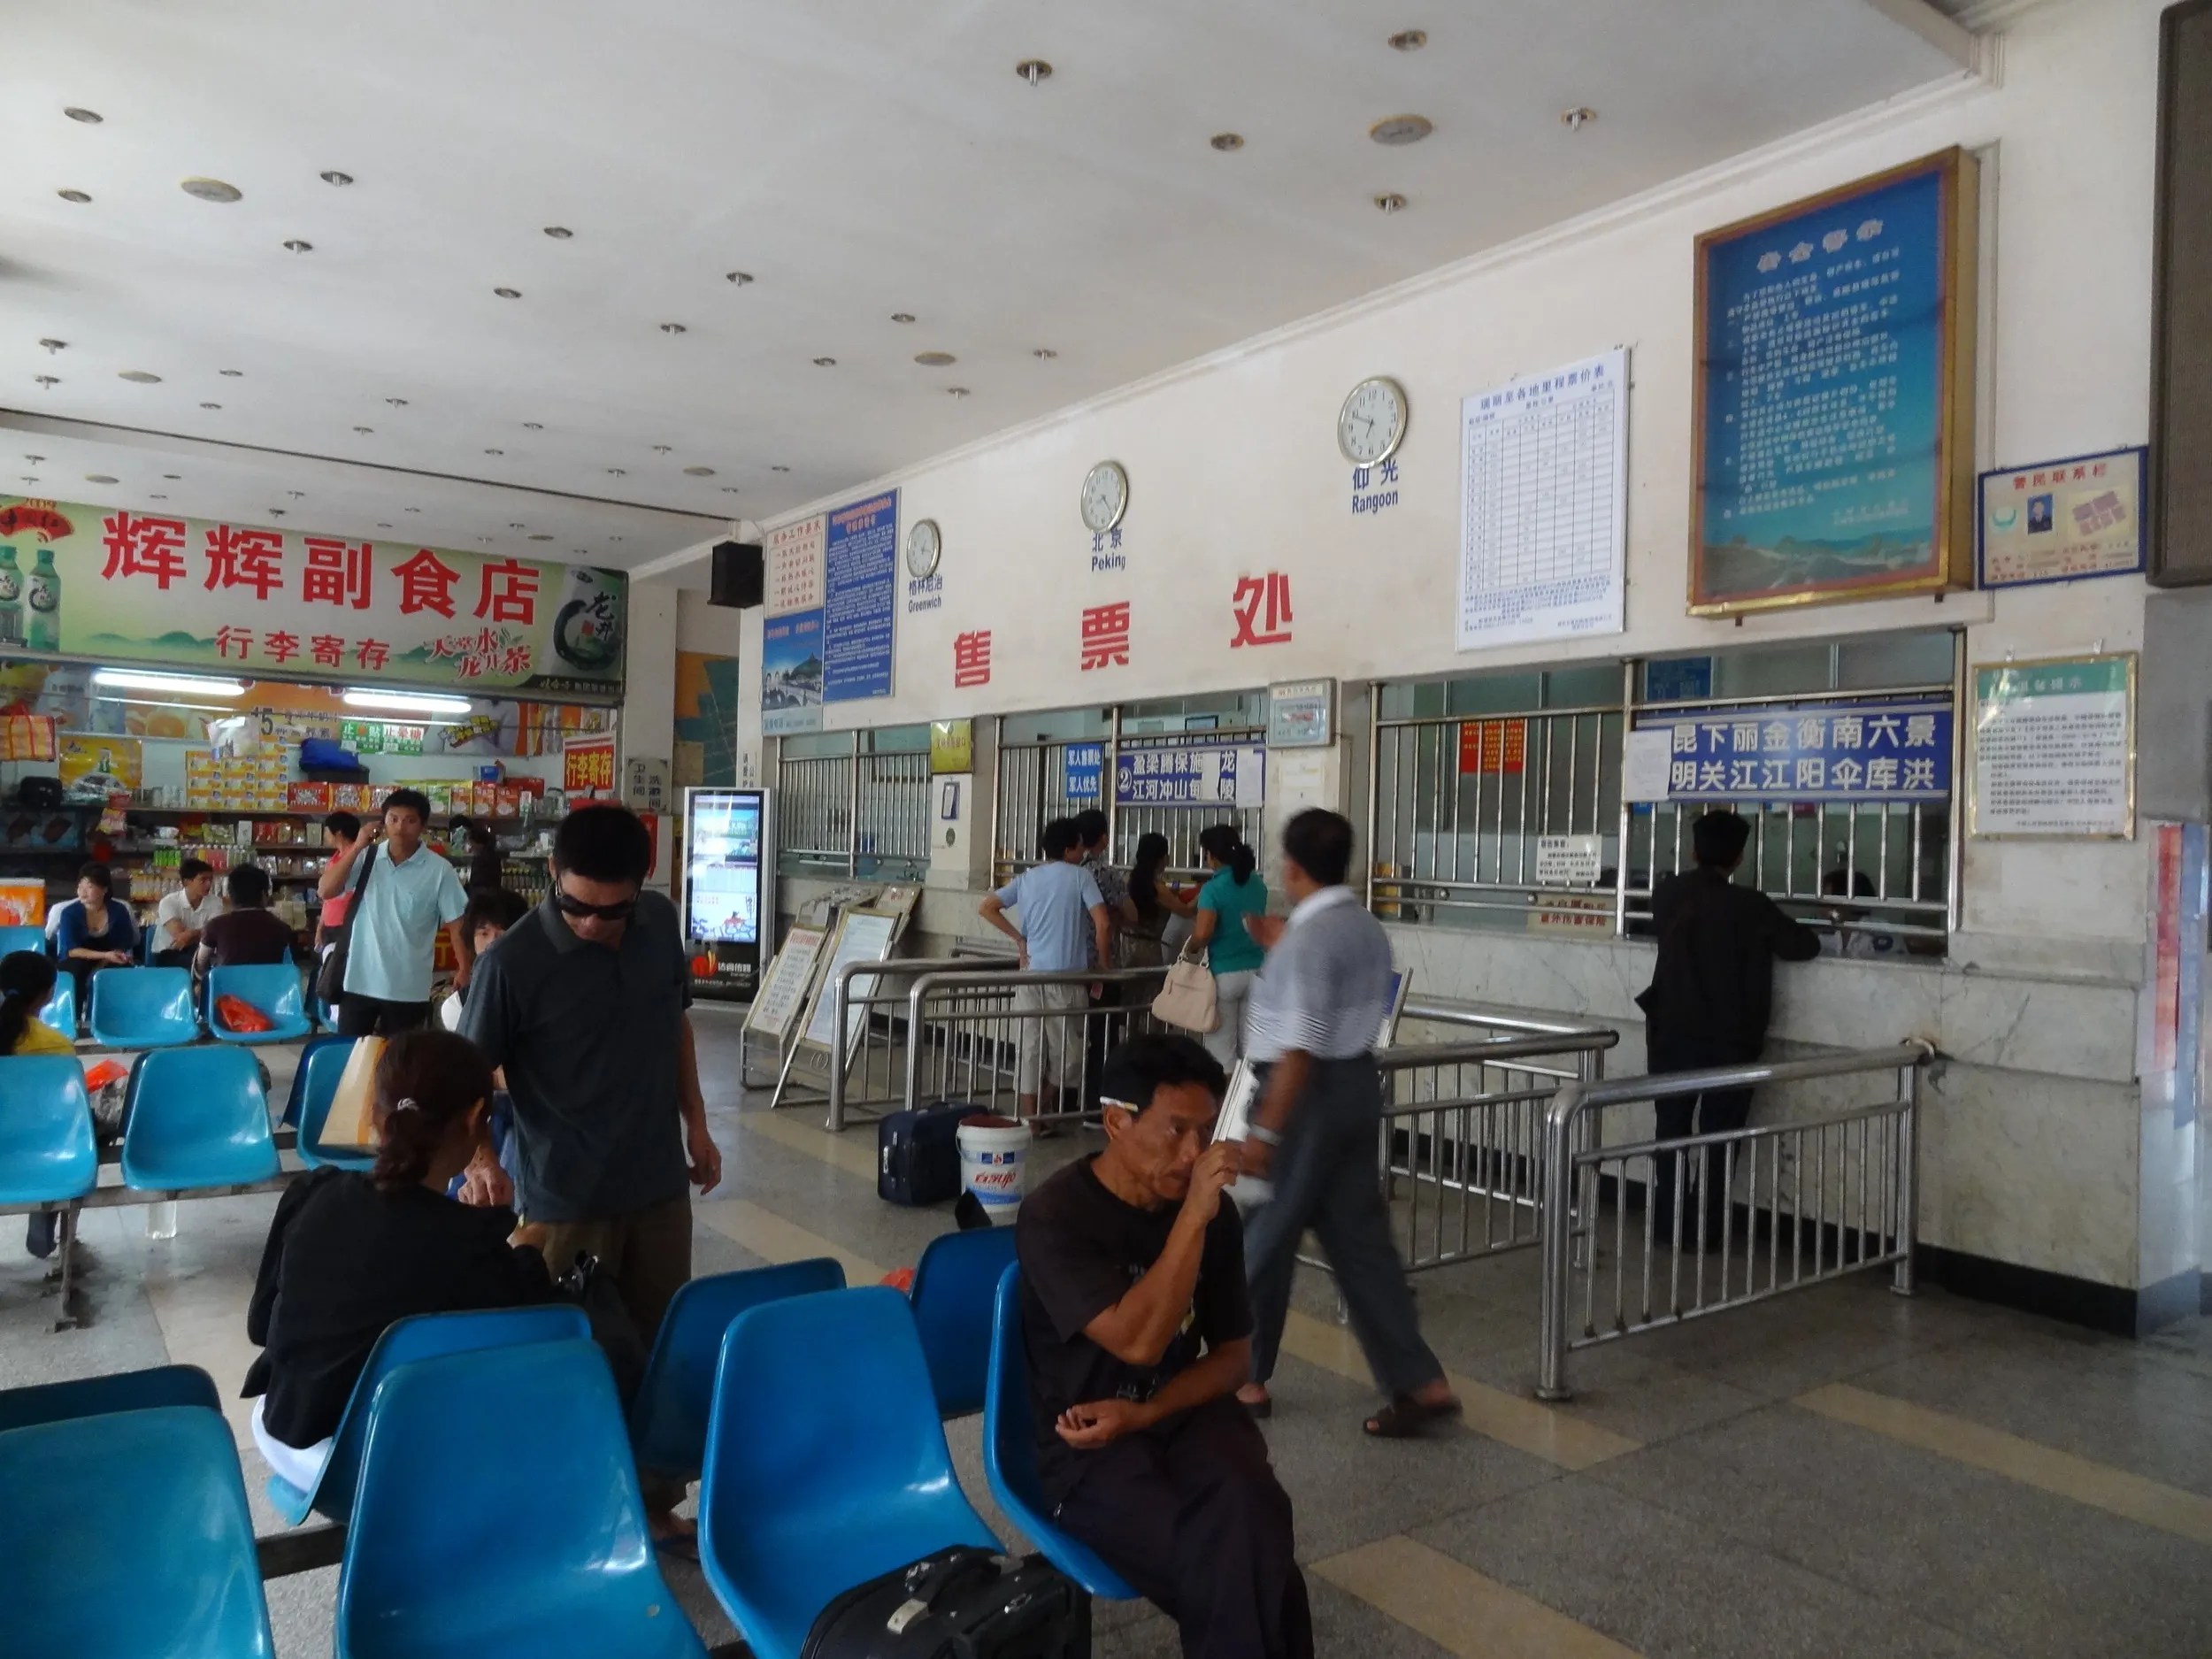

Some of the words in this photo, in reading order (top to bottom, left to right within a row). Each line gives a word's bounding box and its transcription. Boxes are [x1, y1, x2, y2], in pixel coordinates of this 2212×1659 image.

[1480, 364, 1604, 411] 瑞丽至各地里程票价表
[1352, 457, 1398, 491] 仰光
[2013, 463, 2107, 490] 警民联系栏
[1352, 489, 1398, 514] Rangoon
[1092, 528, 1122, 552] 北京
[101, 511, 541, 626] 辉辉副食店
[1092, 552, 1125, 572] Peking
[909, 595, 941, 613] Greenwich
[216, 625, 390, 671] 行李寄存
[565, 750, 612, 787] 行李寄存
